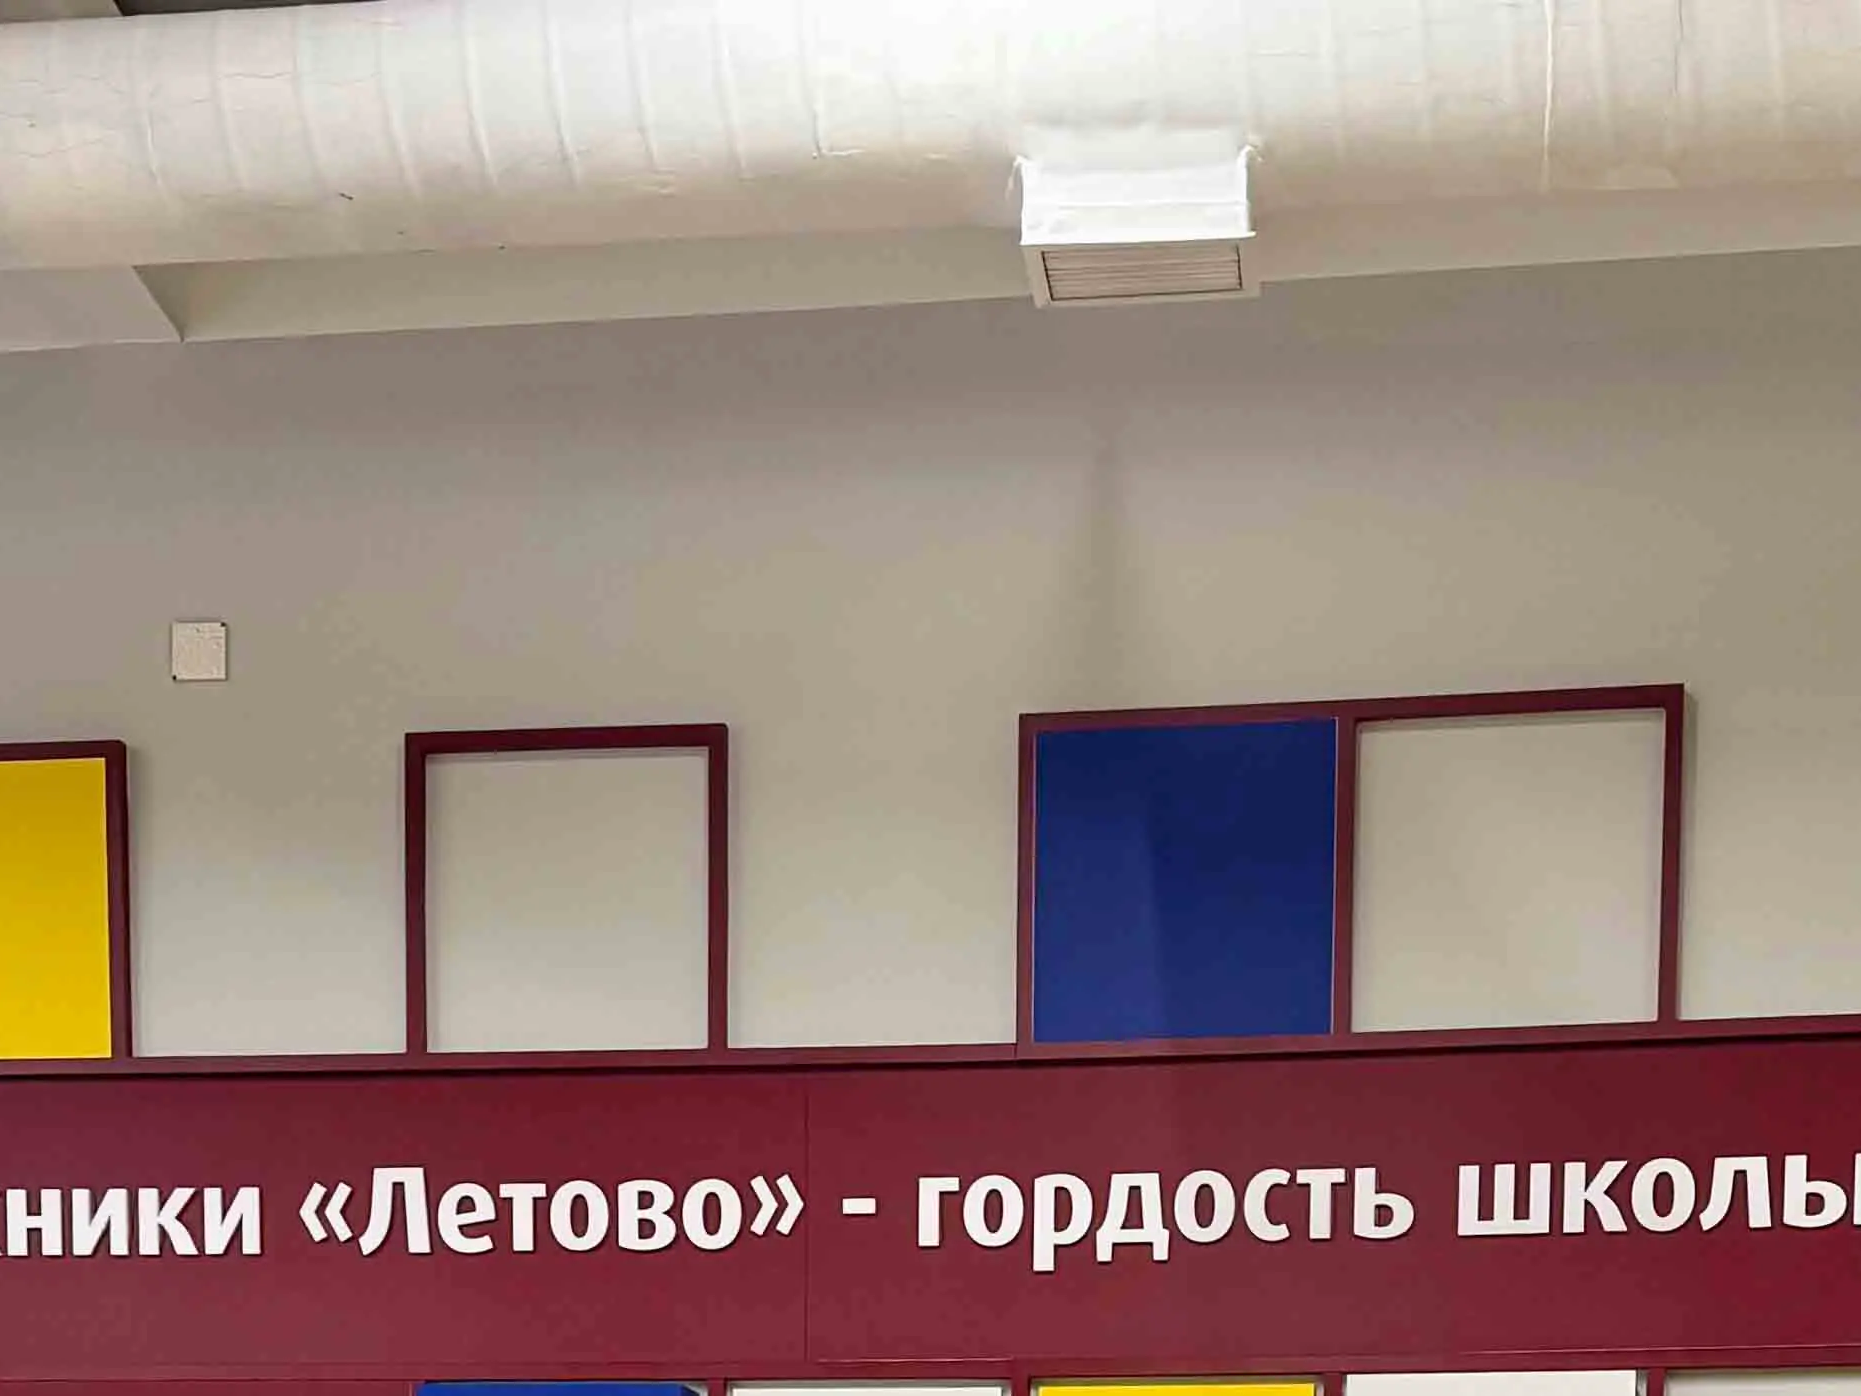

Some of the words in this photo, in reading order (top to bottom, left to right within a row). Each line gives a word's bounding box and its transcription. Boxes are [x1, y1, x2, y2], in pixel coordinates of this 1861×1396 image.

[300, 1168, 803, 1255] «Летово»
[843, 1198, 875, 1214] -
[919, 1168, 1413, 1271] гордость
